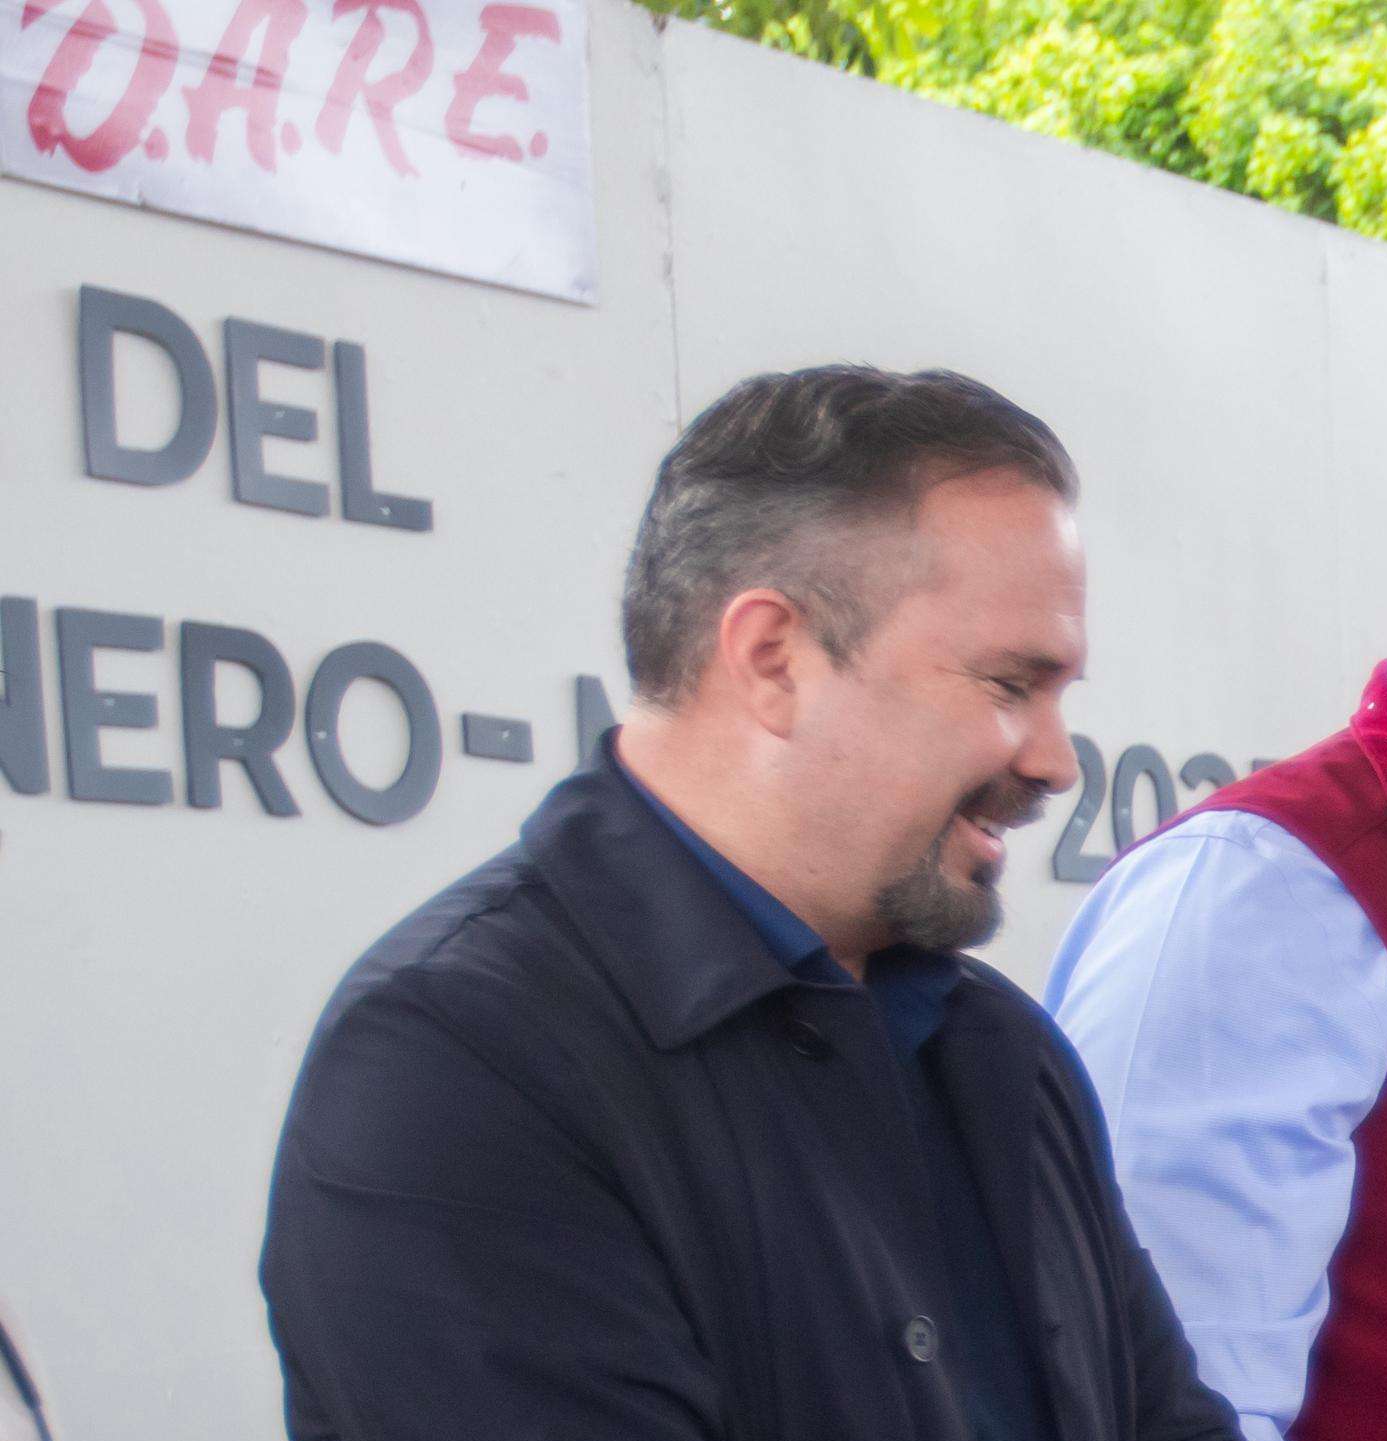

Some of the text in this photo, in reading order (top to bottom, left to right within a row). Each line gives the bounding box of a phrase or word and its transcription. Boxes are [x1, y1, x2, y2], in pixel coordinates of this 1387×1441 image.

[20, 0, 562, 177] D.A.R.E.
[79, 283, 433, 533] DEL
[0, 596, 618, 826] NERO-
[1052, 732, 1281, 884] 20
